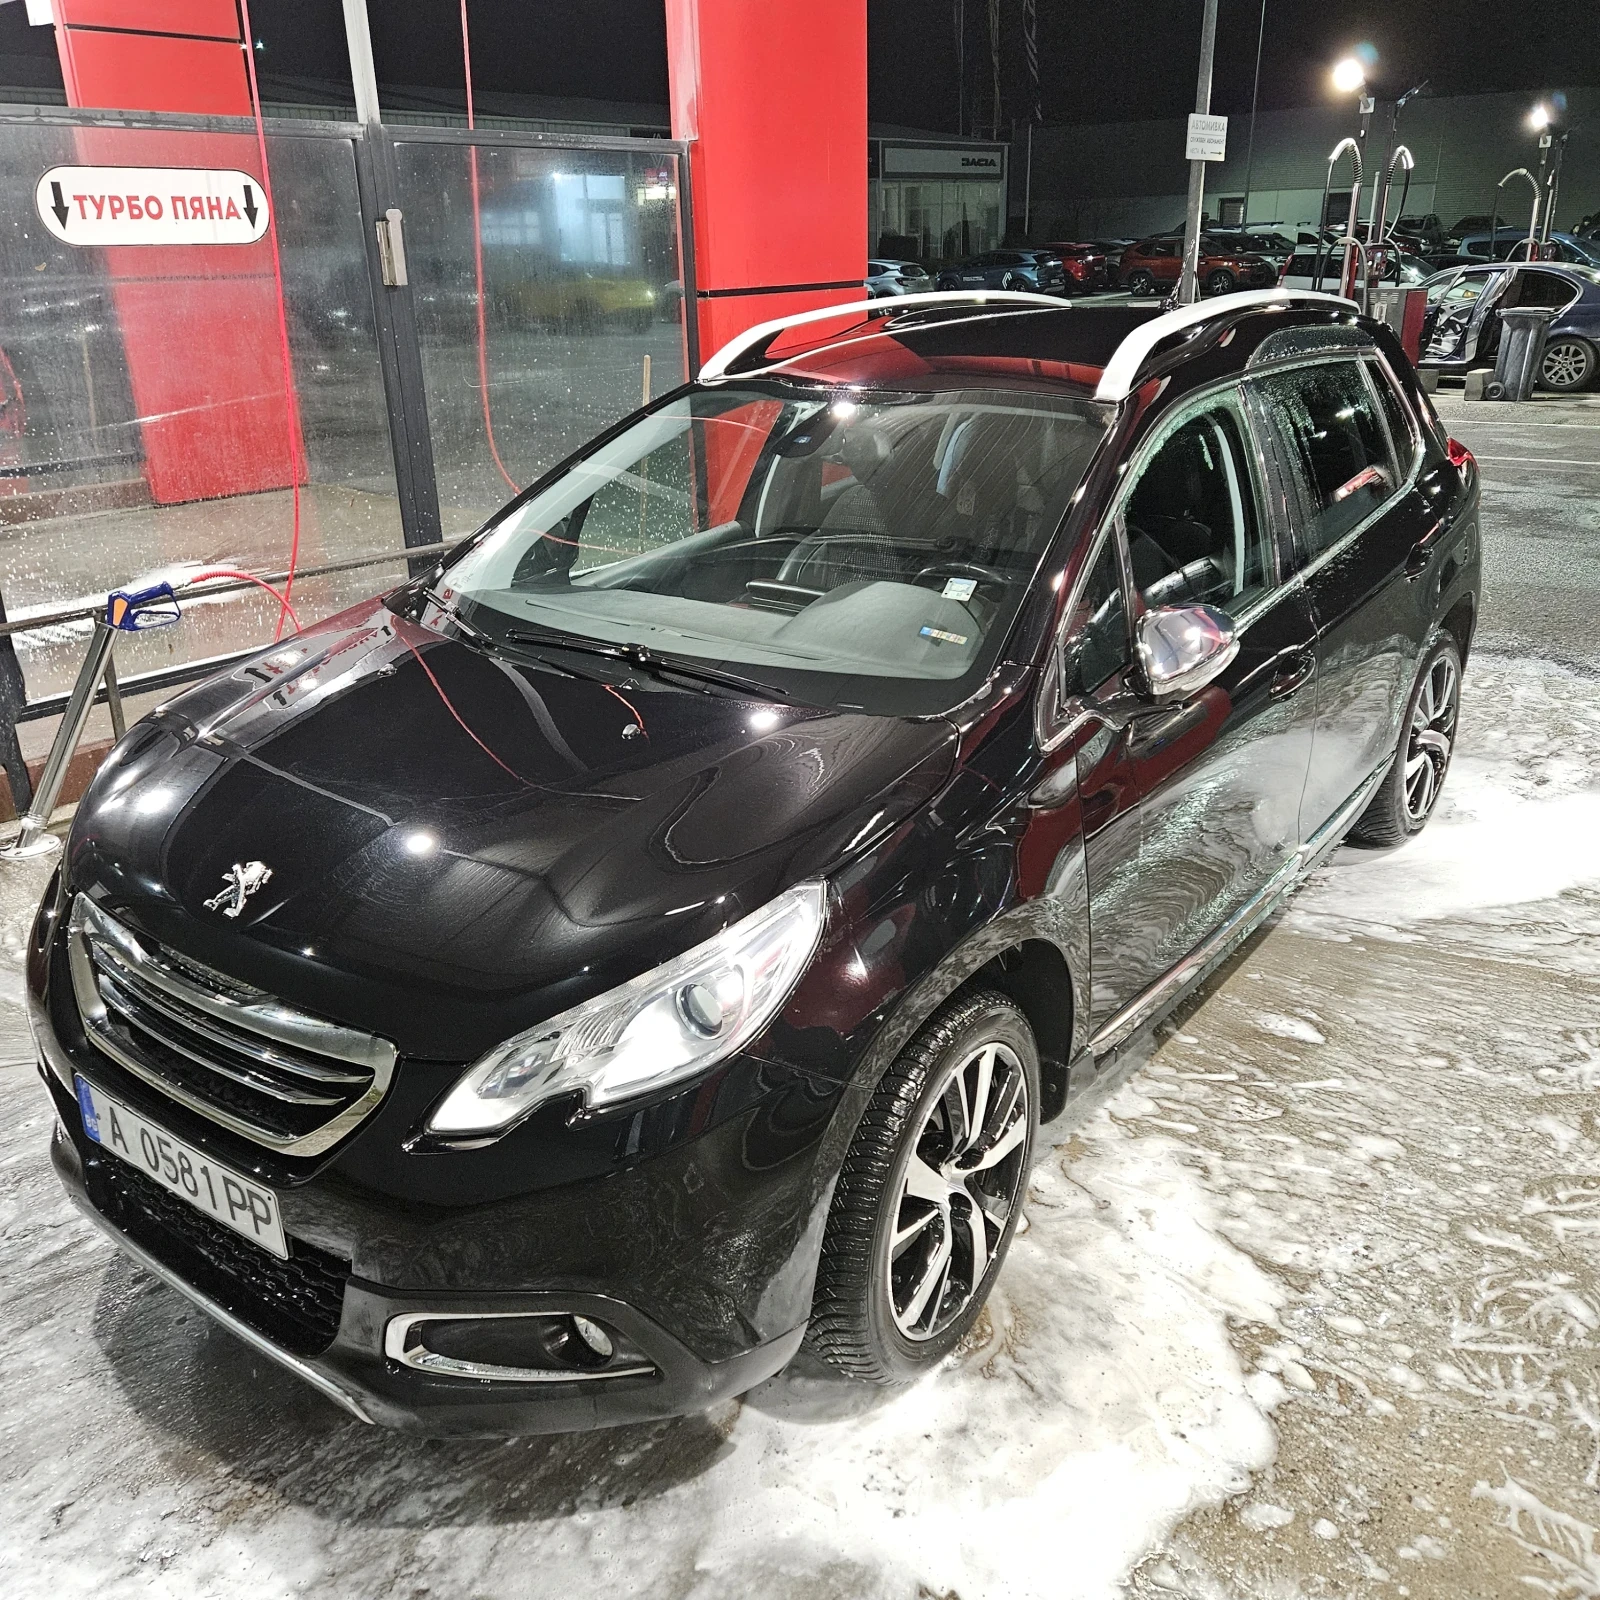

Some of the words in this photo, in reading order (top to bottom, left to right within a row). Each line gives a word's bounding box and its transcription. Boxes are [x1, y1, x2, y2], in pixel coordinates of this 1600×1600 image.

[1192, 120, 1225, 132] АВТОМИВКА
[961, 157, 997, 167] DACIA
[72, 194, 164, 220] ТУРБО
[170, 195, 242, 220] ПЯНА
[84, 1113, 98, 1132] BG
[109, 1106, 130, 1155] A
